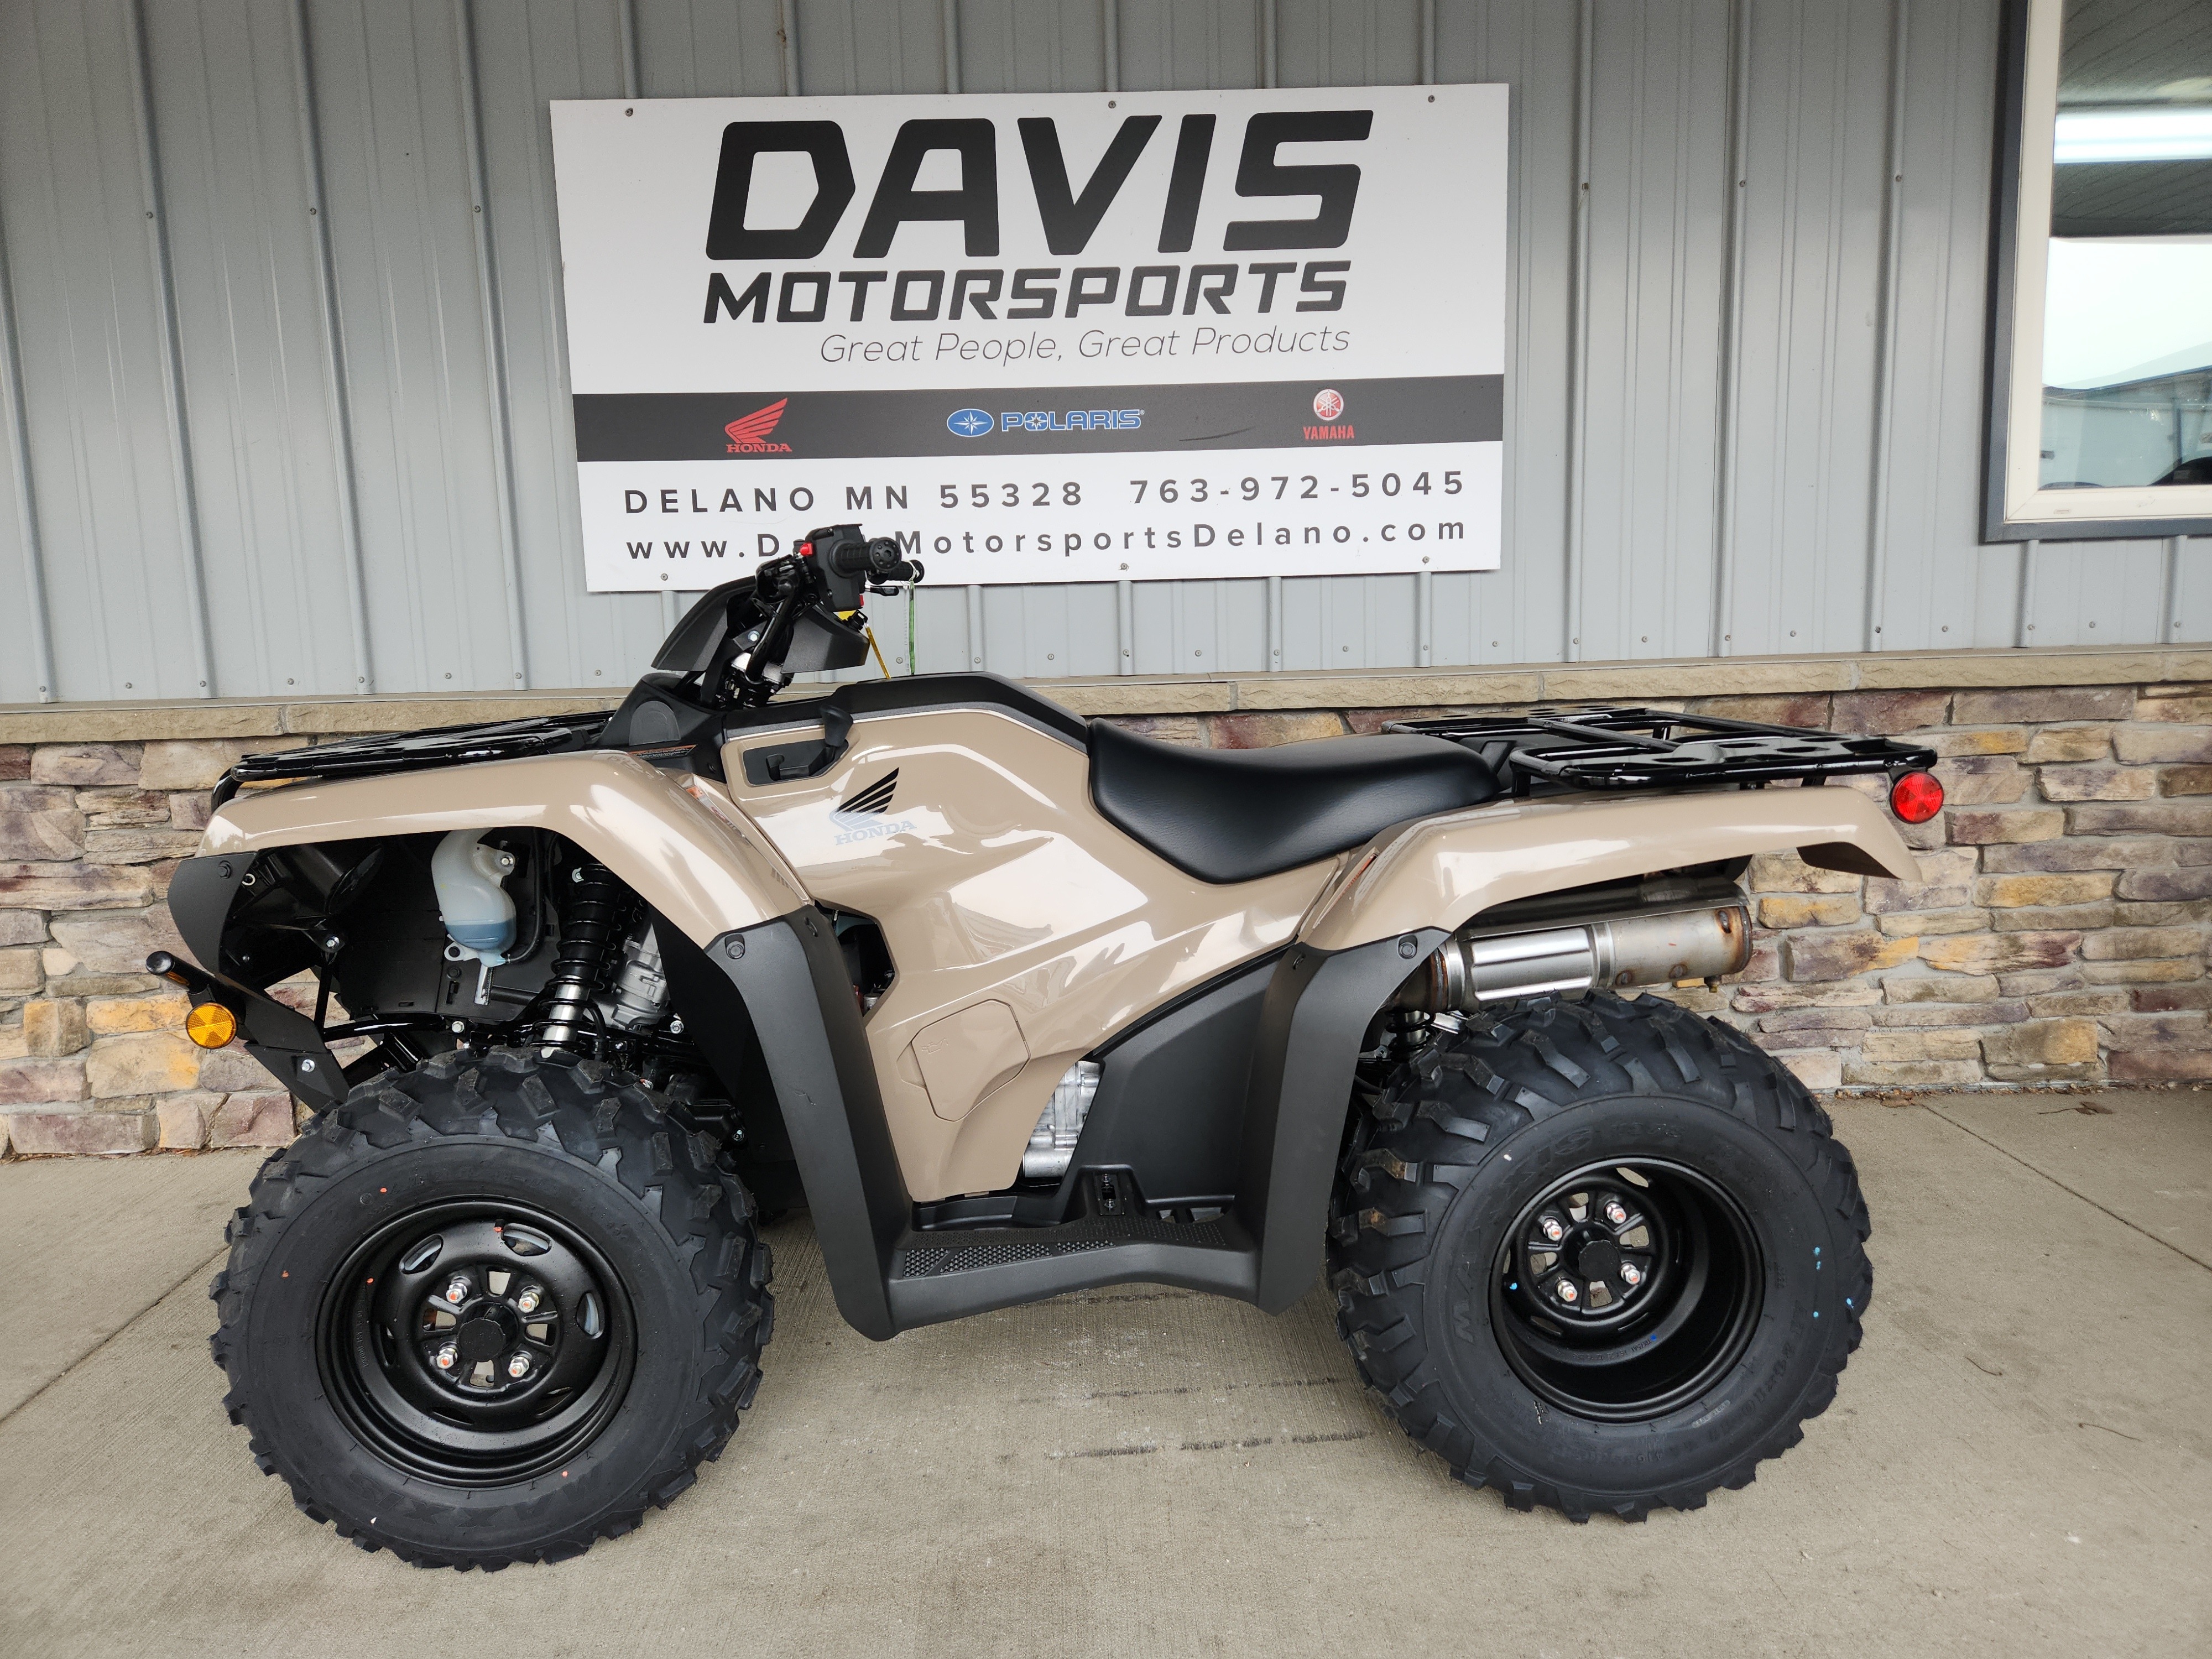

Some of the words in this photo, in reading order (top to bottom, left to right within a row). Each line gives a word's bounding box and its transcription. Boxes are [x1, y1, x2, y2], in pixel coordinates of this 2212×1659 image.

[705, 110, 1374, 260] DAVIS
[703, 261, 1352, 324] MOTORSPORTS
[821, 334, 923, 362] Great
[935, 331, 1062, 367] People,
[1079, 330, 1180, 357] Great
[1192, 325, 1350, 355] Products
[1001, 409, 1141, 432] POLARIS
[1303, 425, 1355, 440] YAMAHA
[726, 443, 792, 453] HONDA
[625, 487, 813, 514] DELANO
[846, 486, 907, 510] MN
[940, 482, 1081, 508] 55328
[1130, 471, 1463, 504] 763-972-5045
[626, 522, 1463, 559] www.DMotorsportsDelano.com
[834, 820, 917, 846] HONDA
